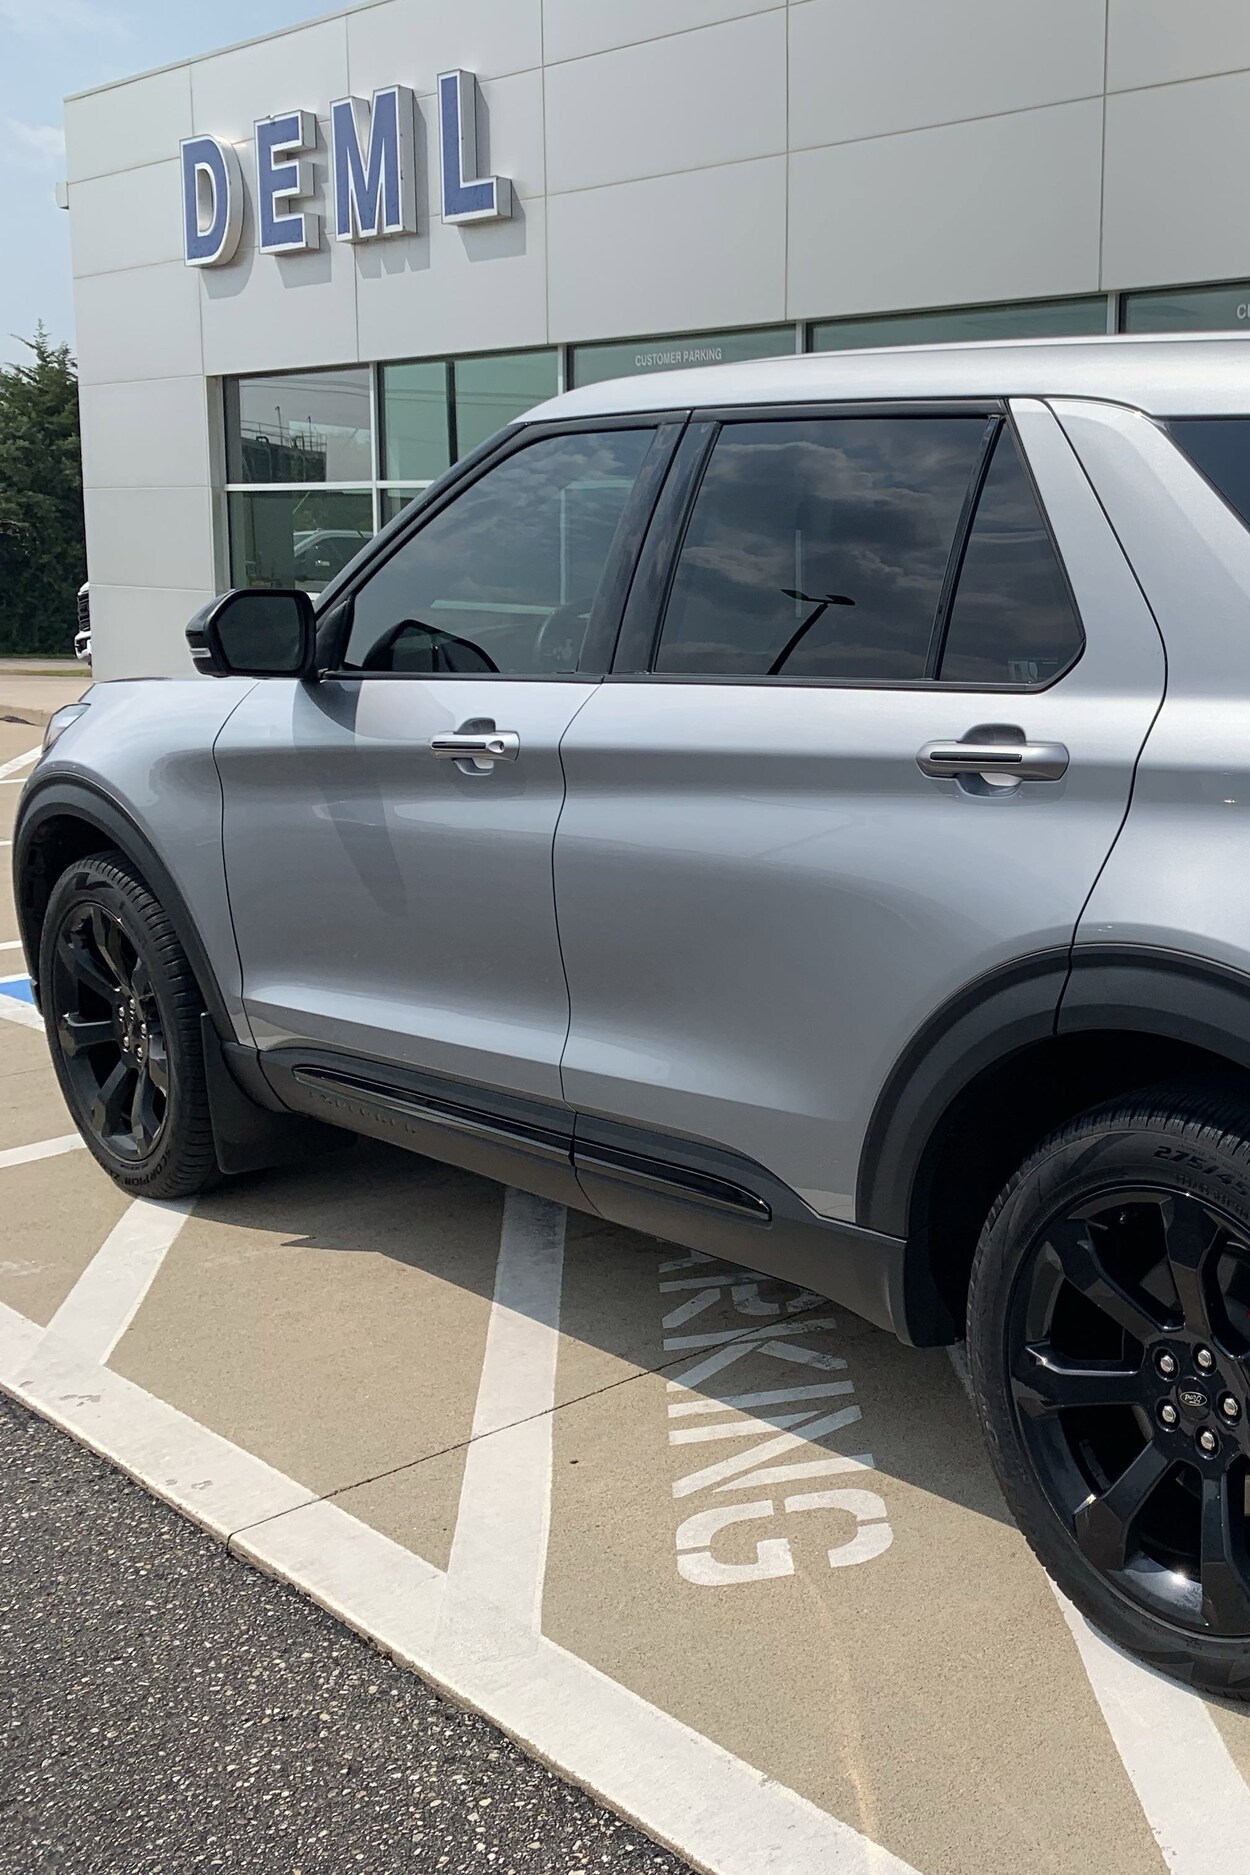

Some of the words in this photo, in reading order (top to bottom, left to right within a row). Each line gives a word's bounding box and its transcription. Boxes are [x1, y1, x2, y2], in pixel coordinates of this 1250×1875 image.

[180, 68, 512, 267] DEML
[635, 351, 681, 367] CUSTOMER
[683, 347, 722, 363] PARKING
